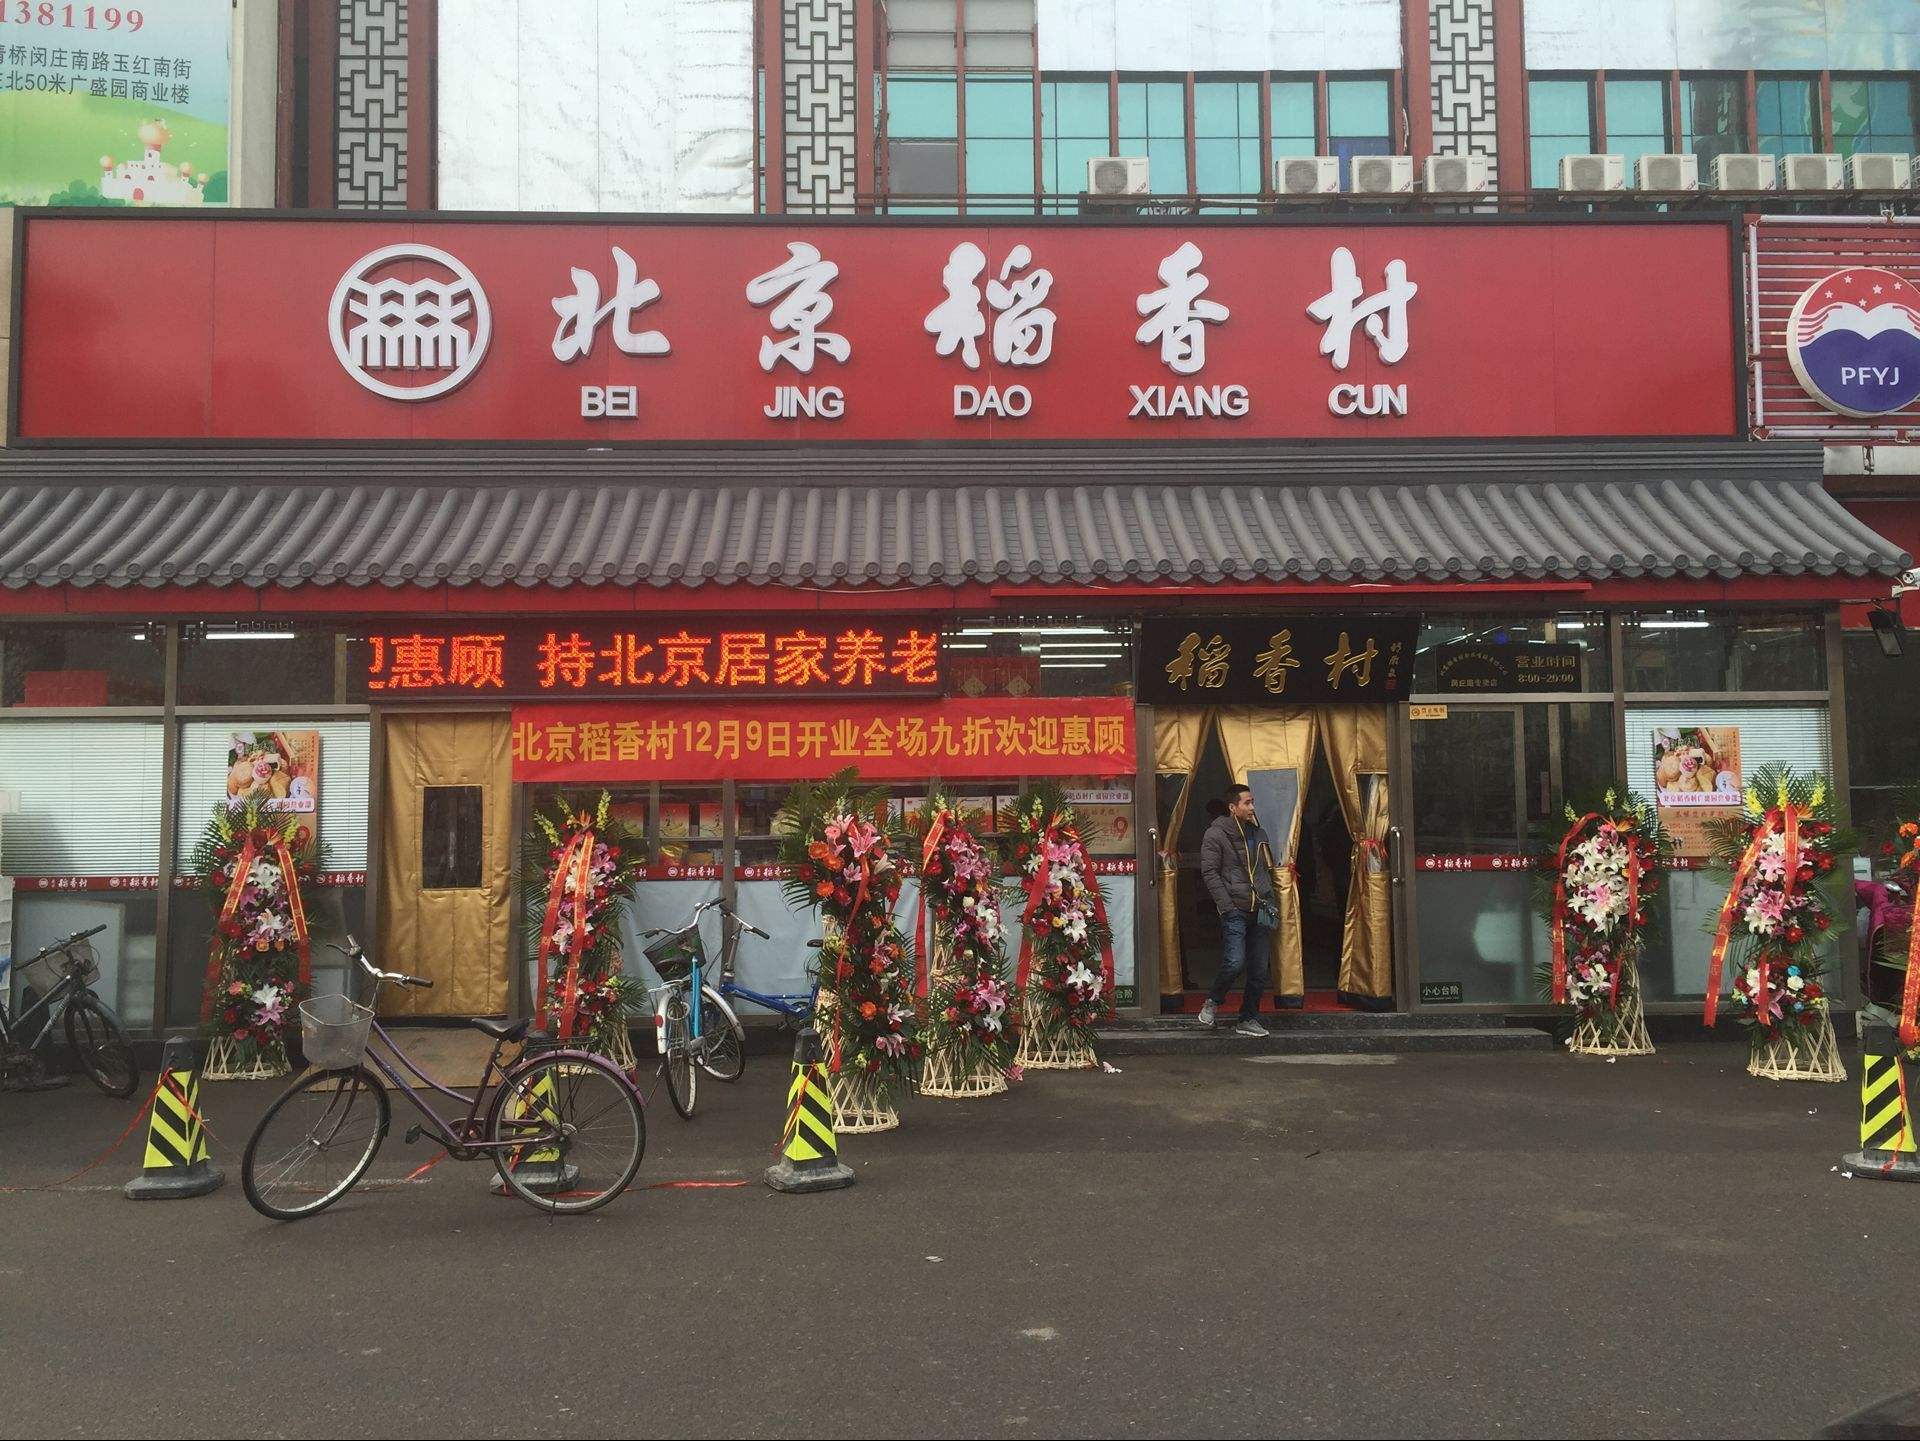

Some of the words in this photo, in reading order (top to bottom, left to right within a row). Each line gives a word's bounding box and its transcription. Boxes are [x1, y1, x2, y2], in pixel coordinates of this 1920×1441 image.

[0, 70, 190, 105] 北50米广盛园商业楼
[551, 241, 1418, 376] 北京稻香村
[1841, 366, 1900, 386] PFYJ
[581, 385, 638, 418] BEI
[763, 386, 845, 418] JING
[953, 385, 1032, 418] DAO
[1128, 384, 1250, 418] XIANG
[1328, 383, 1408, 416] CUN
[537, 630, 938, 687] 持北京居家养老
[1165, 629, 1379, 694] 稻香村
[1514, 655, 1576, 668] 营业时间
[1518, 673, 1574, 683] 8:00-20:00
[511, 715, 1126, 763] 北京稻香村12月9日开业全场九折欢迎惠顾
